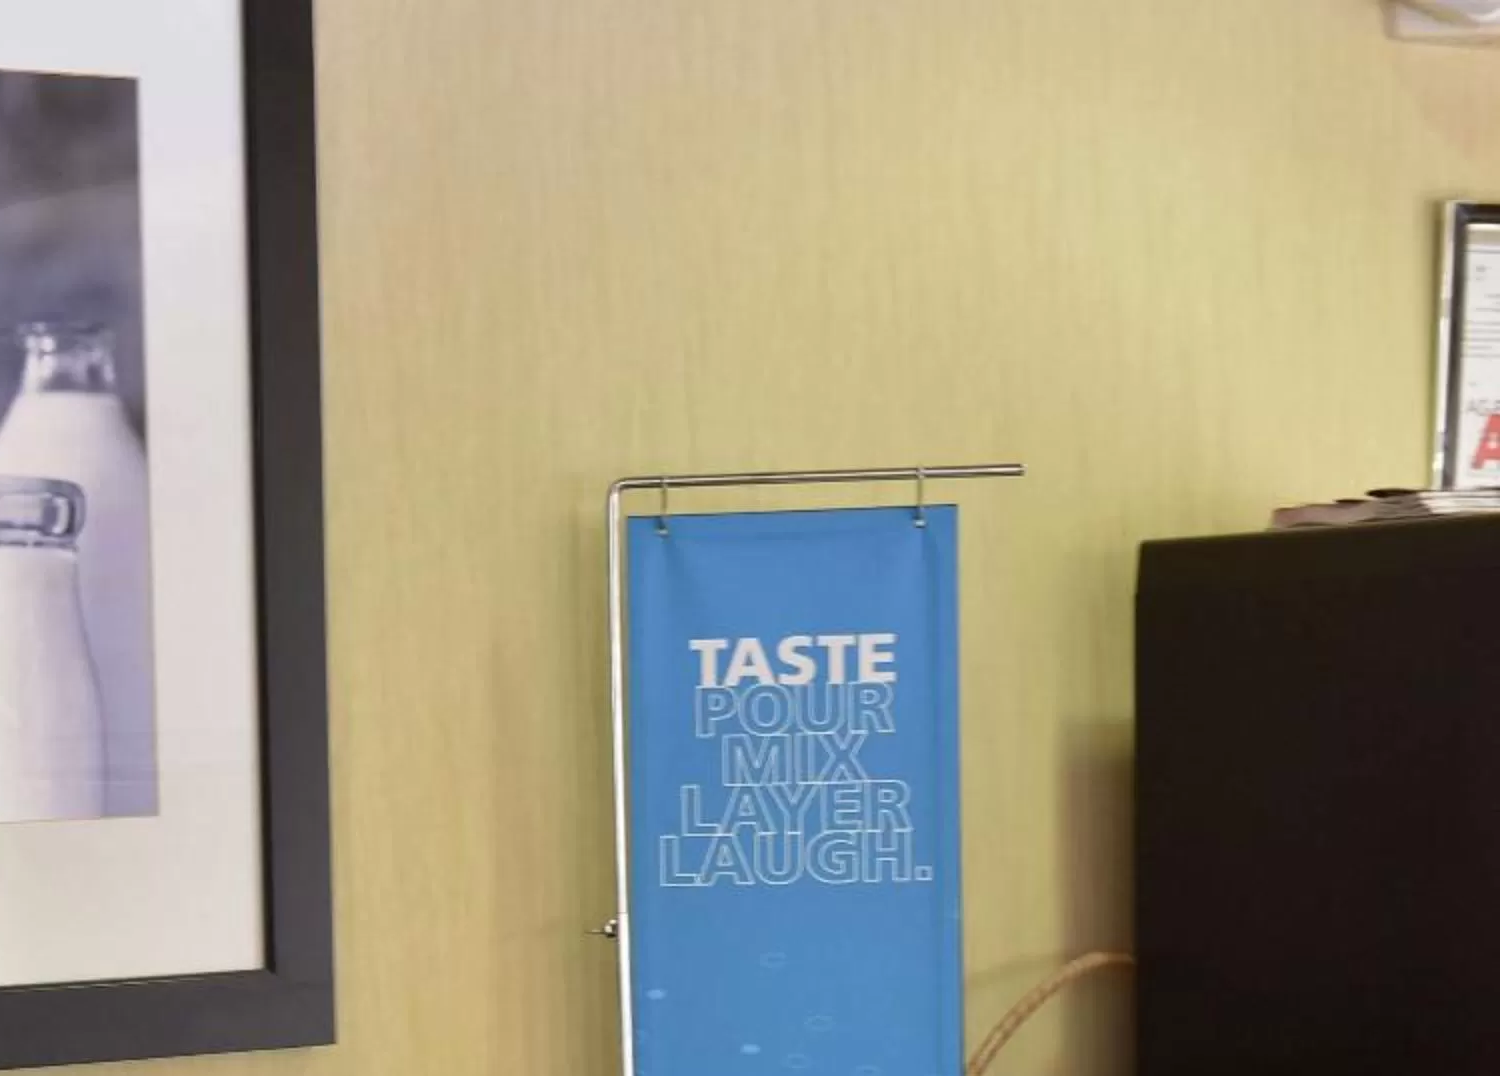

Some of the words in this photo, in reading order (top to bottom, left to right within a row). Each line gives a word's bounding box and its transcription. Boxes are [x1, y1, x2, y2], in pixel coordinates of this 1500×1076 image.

[688, 633, 897, 688] TASTE
[694, 681, 896, 738] POUR
[721, 730, 869, 787] MIX
[679, 779, 914, 837] LAYER
[659, 829, 933, 887] LAUGH.
